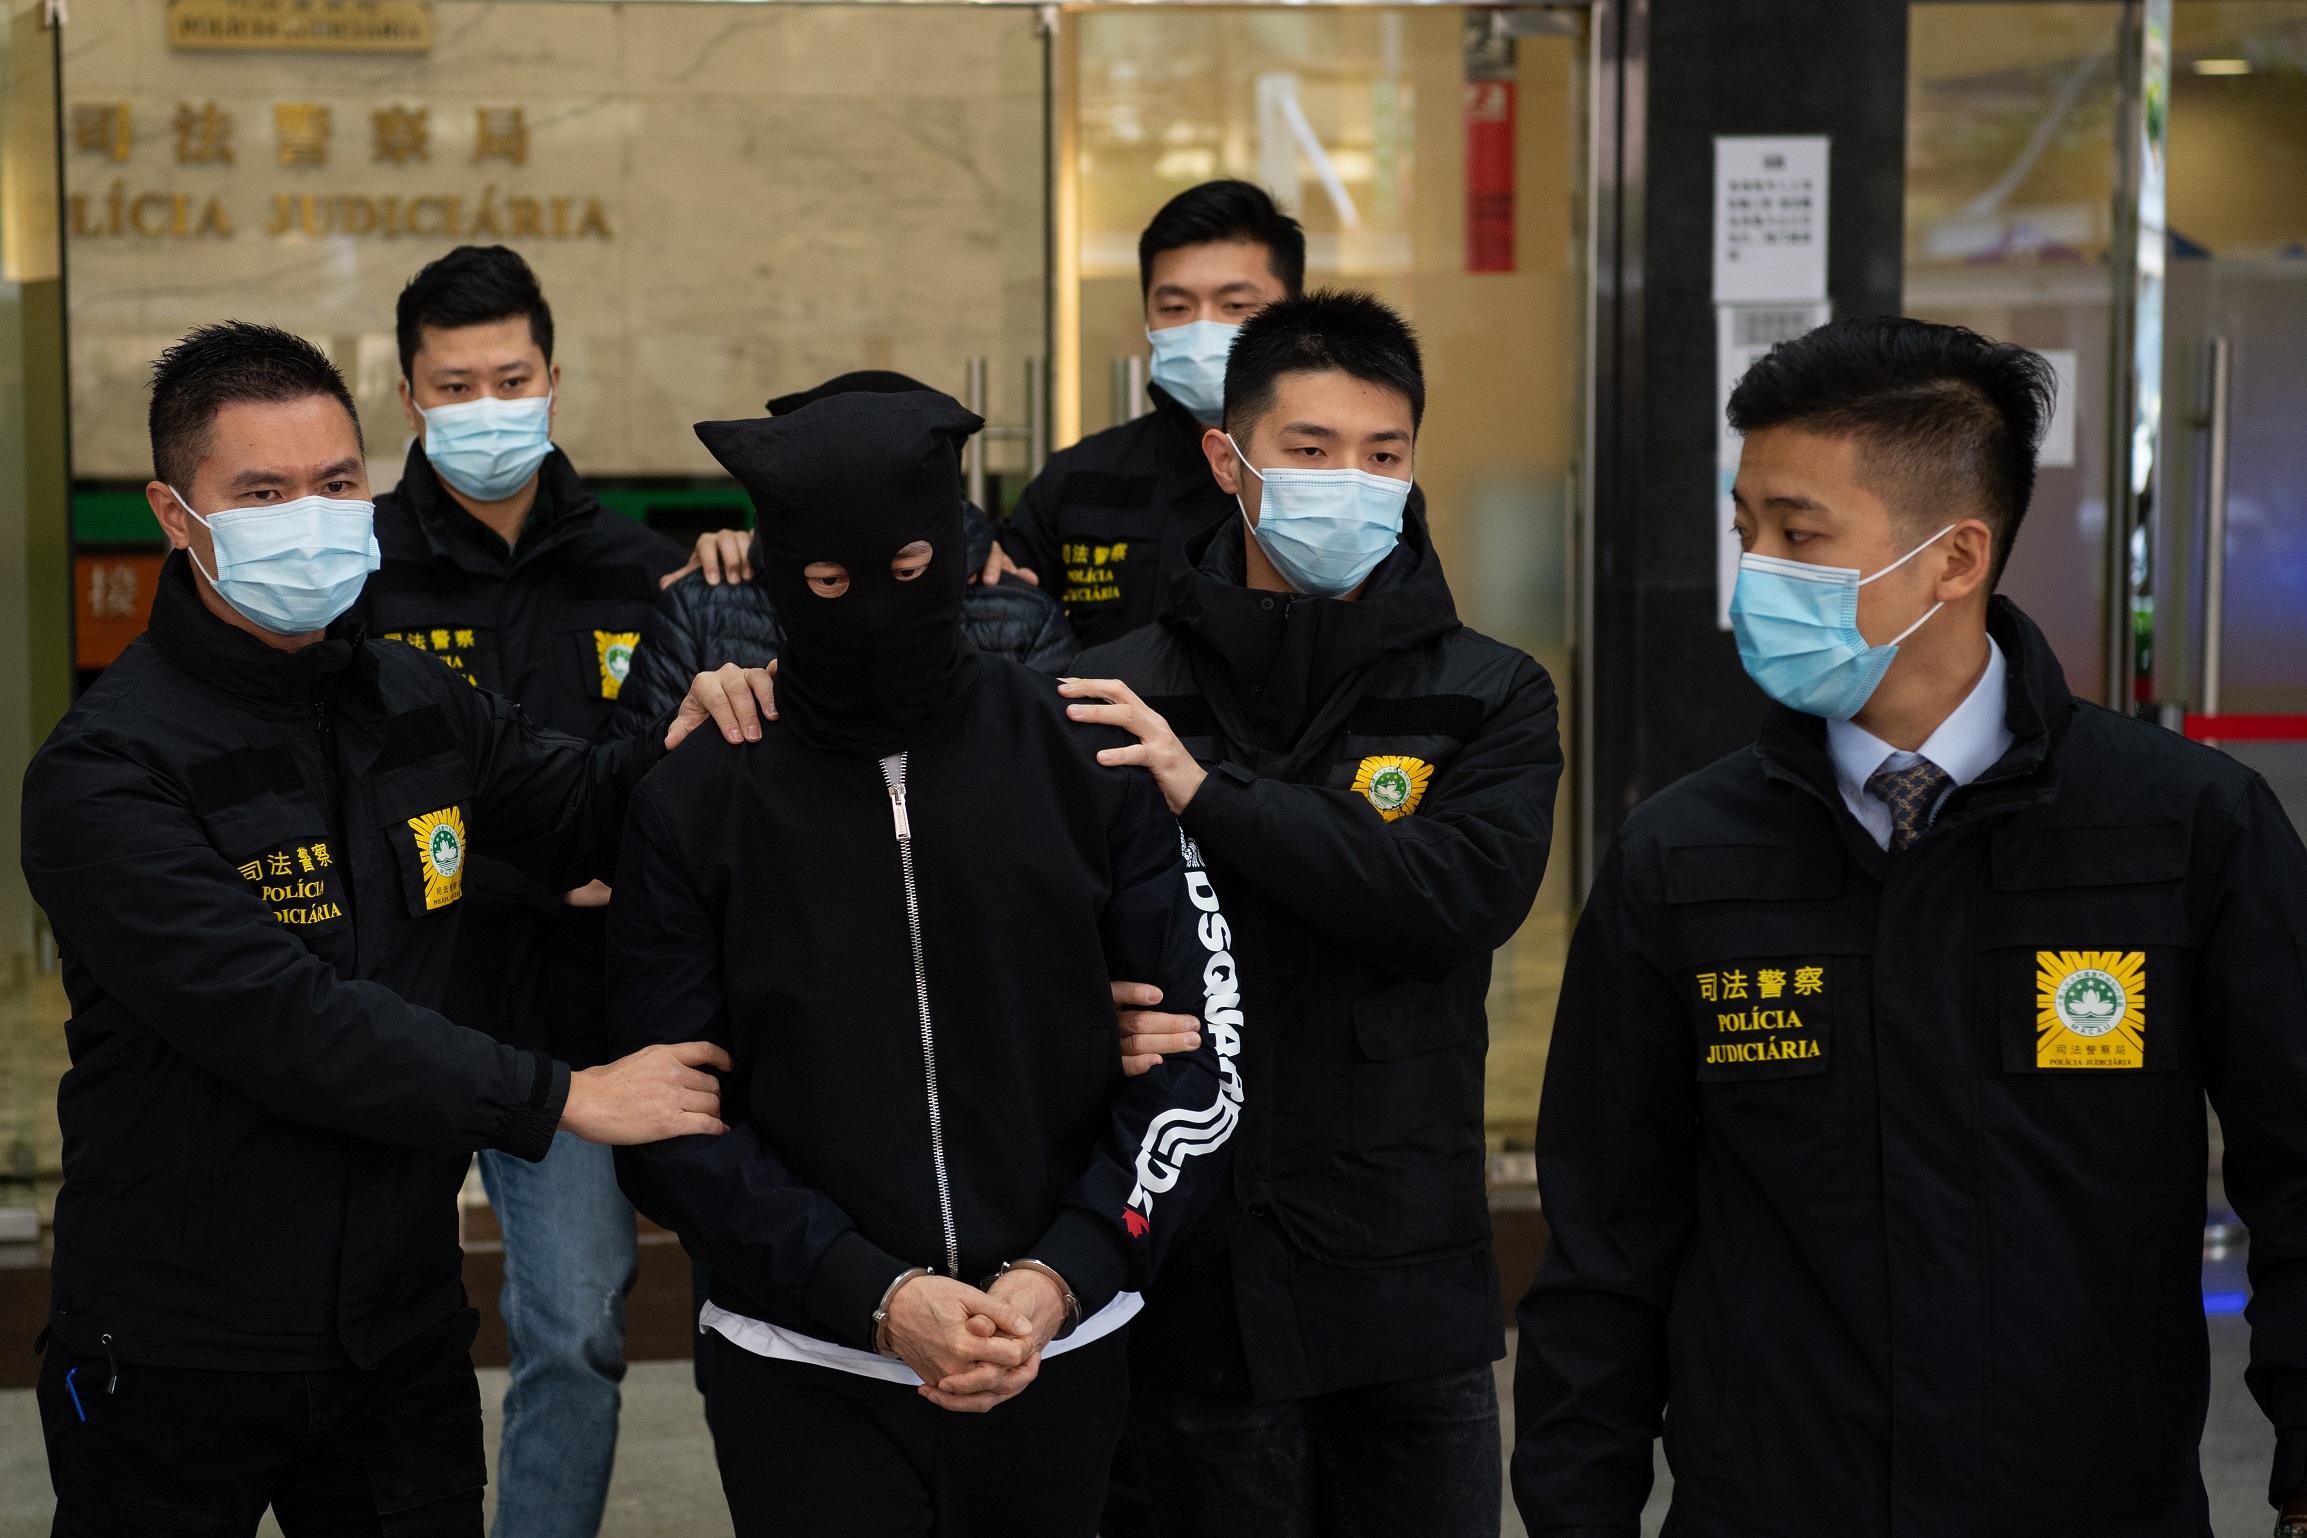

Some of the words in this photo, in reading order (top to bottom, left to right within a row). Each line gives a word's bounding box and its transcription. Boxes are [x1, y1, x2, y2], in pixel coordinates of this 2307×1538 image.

[71, 178, 235, 239] LÍCIA
[265, 185, 614, 241] JUDICIÁRIA
[237, 843, 333, 881] 司法警察
[273, 902, 343, 925] DICIÁRIA
[1696, 966, 1824, 1002] 司法警察
[1717, 1005, 1804, 1032] POLÍCIA
[2071, 1023, 2111, 1036] MACAU
[1706, 1035, 1822, 1064] JUDICIÁRIA
